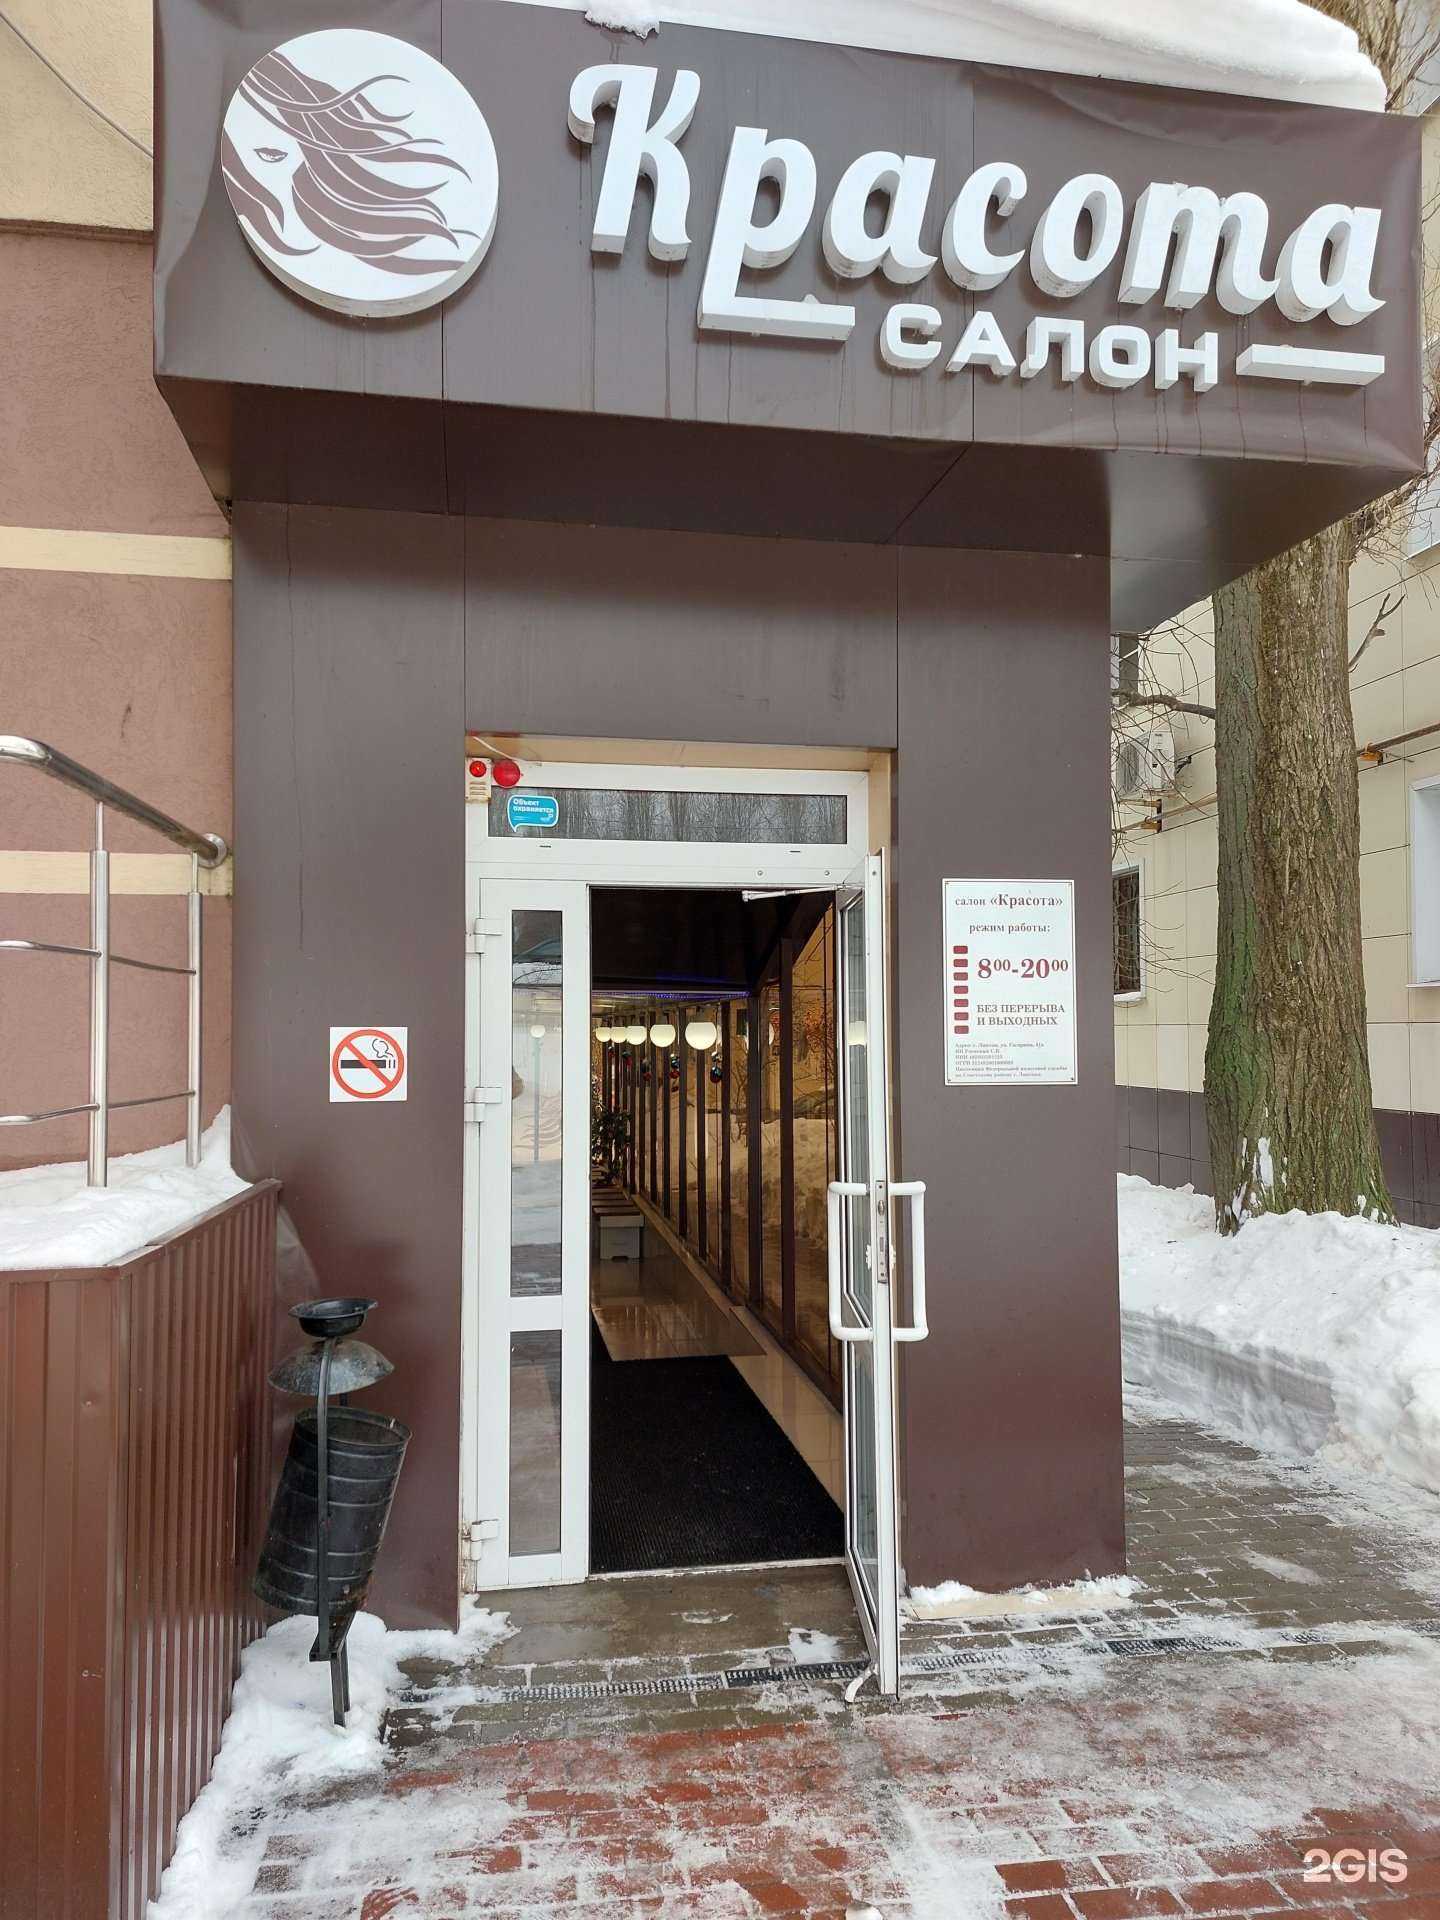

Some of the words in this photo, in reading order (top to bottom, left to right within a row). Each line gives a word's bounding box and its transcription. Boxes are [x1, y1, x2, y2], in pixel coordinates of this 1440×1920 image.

[568, 64, 1386, 338] Красота
[880, 303, 1218, 392] САЛОН
[955, 898, 986, 906] салон
[990, 893, 1063, 909] «Красота»
[969, 923, 1005, 934] режим
[1008, 922, 1051, 934] работы:
[977, 1004, 998, 1013] БЕЗ
[1001, 1004, 1065, 1013] ПЕРЕРЫВА
[977, 1017, 985, 1026] И
[988, 1017, 1058, 1027] ВЫХОДНЫХ
